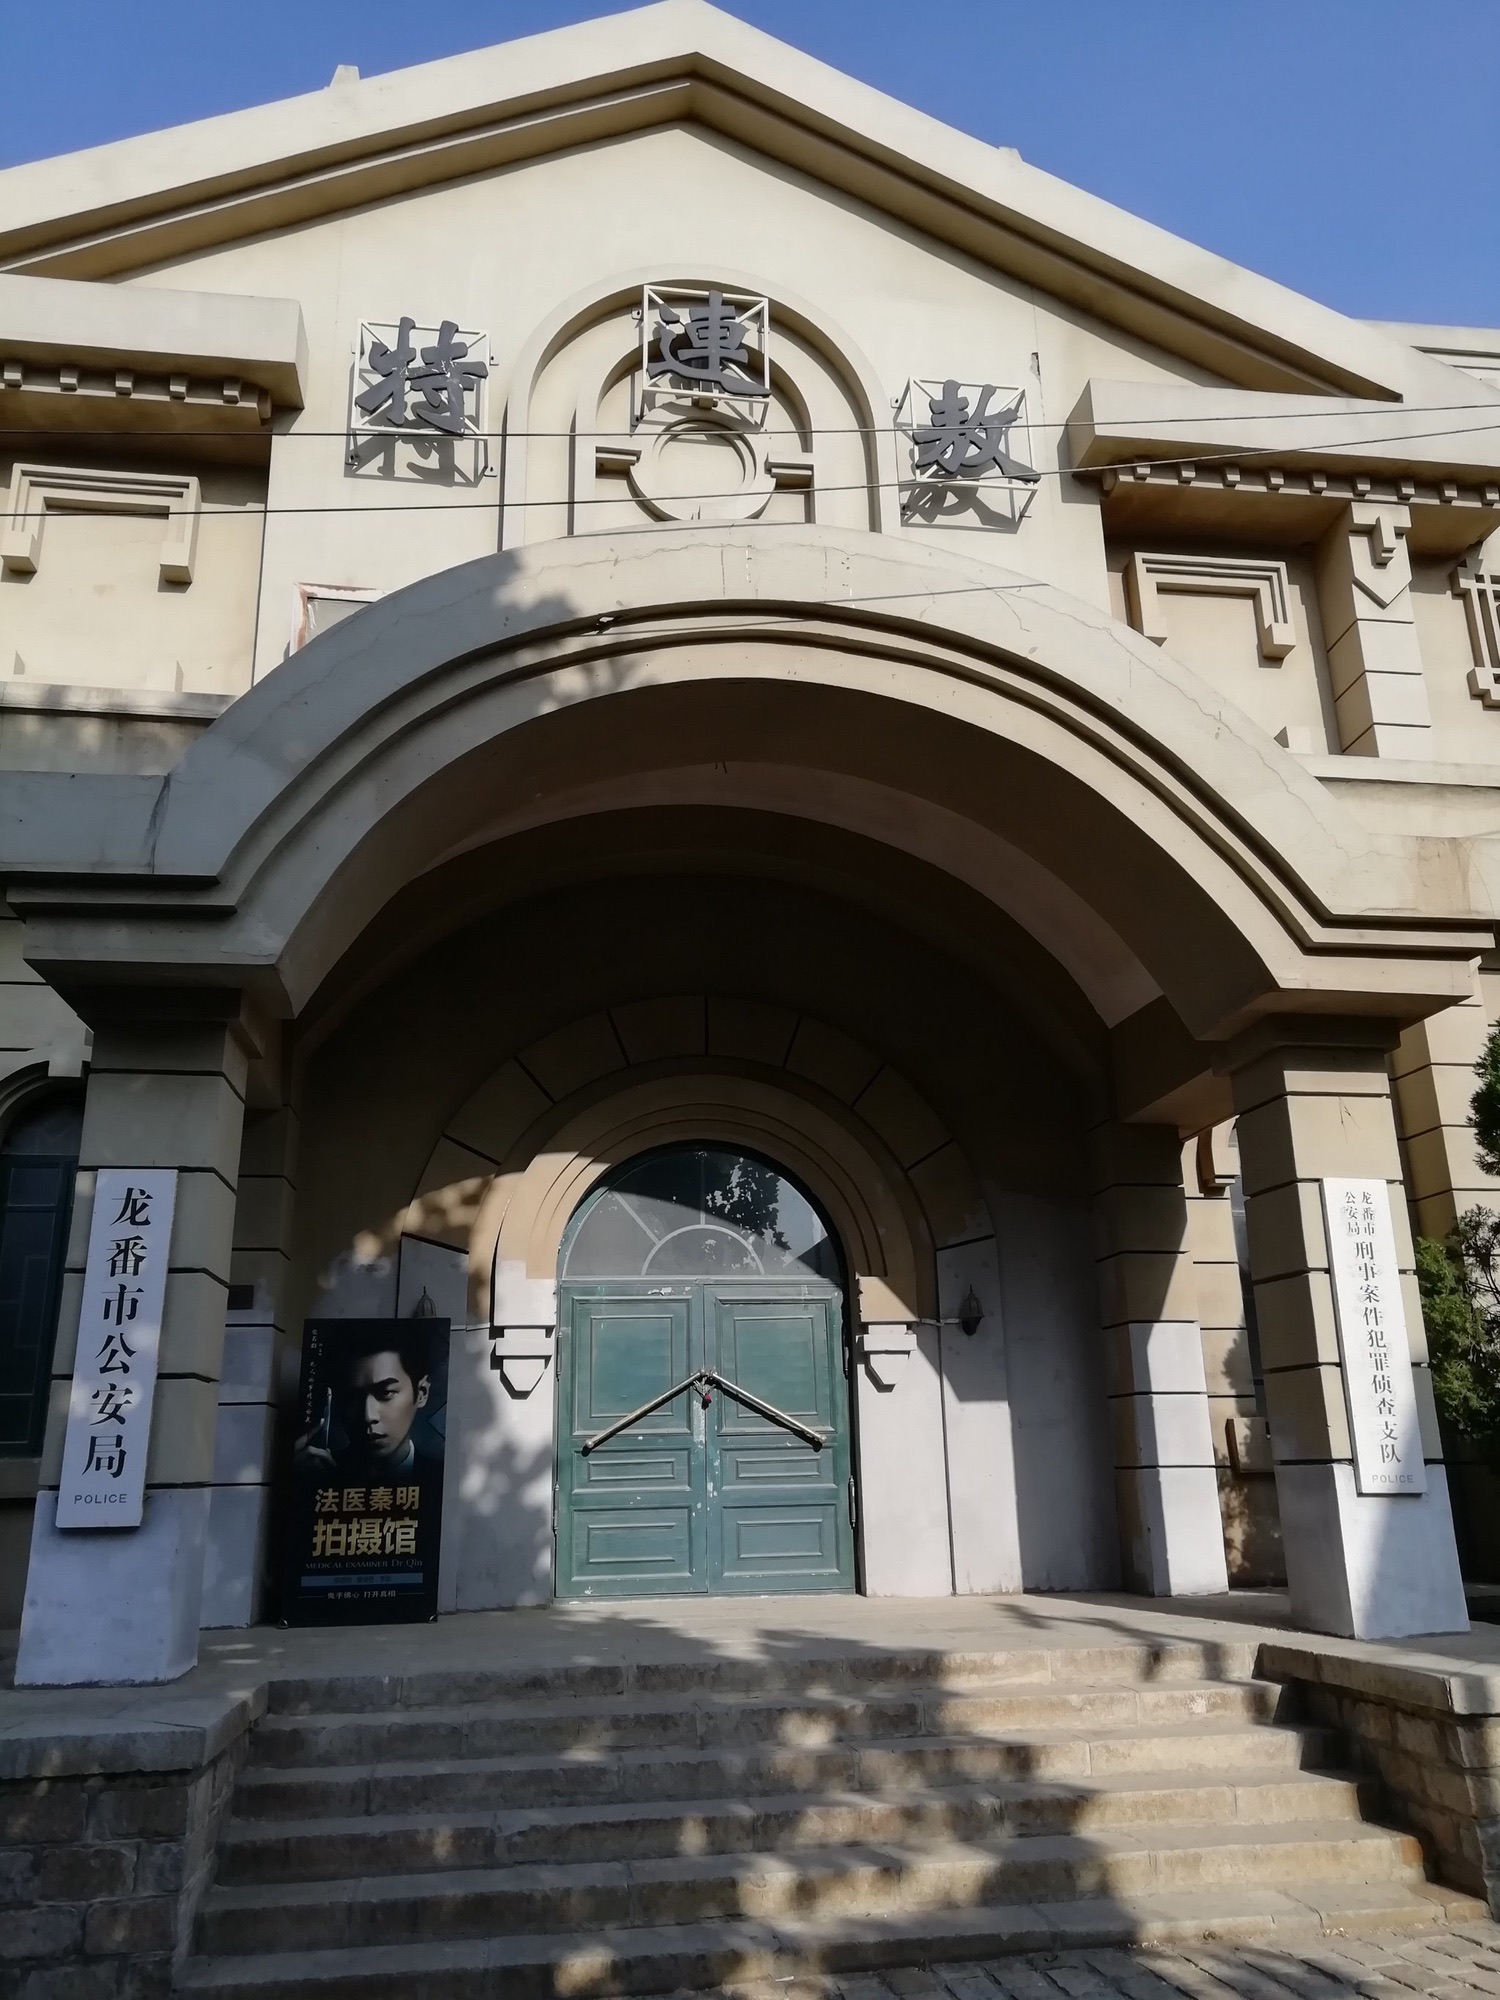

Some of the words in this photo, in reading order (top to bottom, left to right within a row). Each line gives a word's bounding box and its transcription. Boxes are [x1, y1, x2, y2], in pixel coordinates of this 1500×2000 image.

[81, 1187, 154, 1479] 龙番市公安局
[1355, 1241, 1402, 1464] 刑事案件犯罪侦查支队
[1372, 1474, 1414, 1484] POLICE
[74, 1493, 128, 1504] POLICE
[314, 1486, 420, 1513] 法医秦明
[312, 1516, 418, 1557] 拍摄馆
[305, 1561, 342, 1569] MEDICAL
[345, 1560, 388, 1568] EXAMINER
